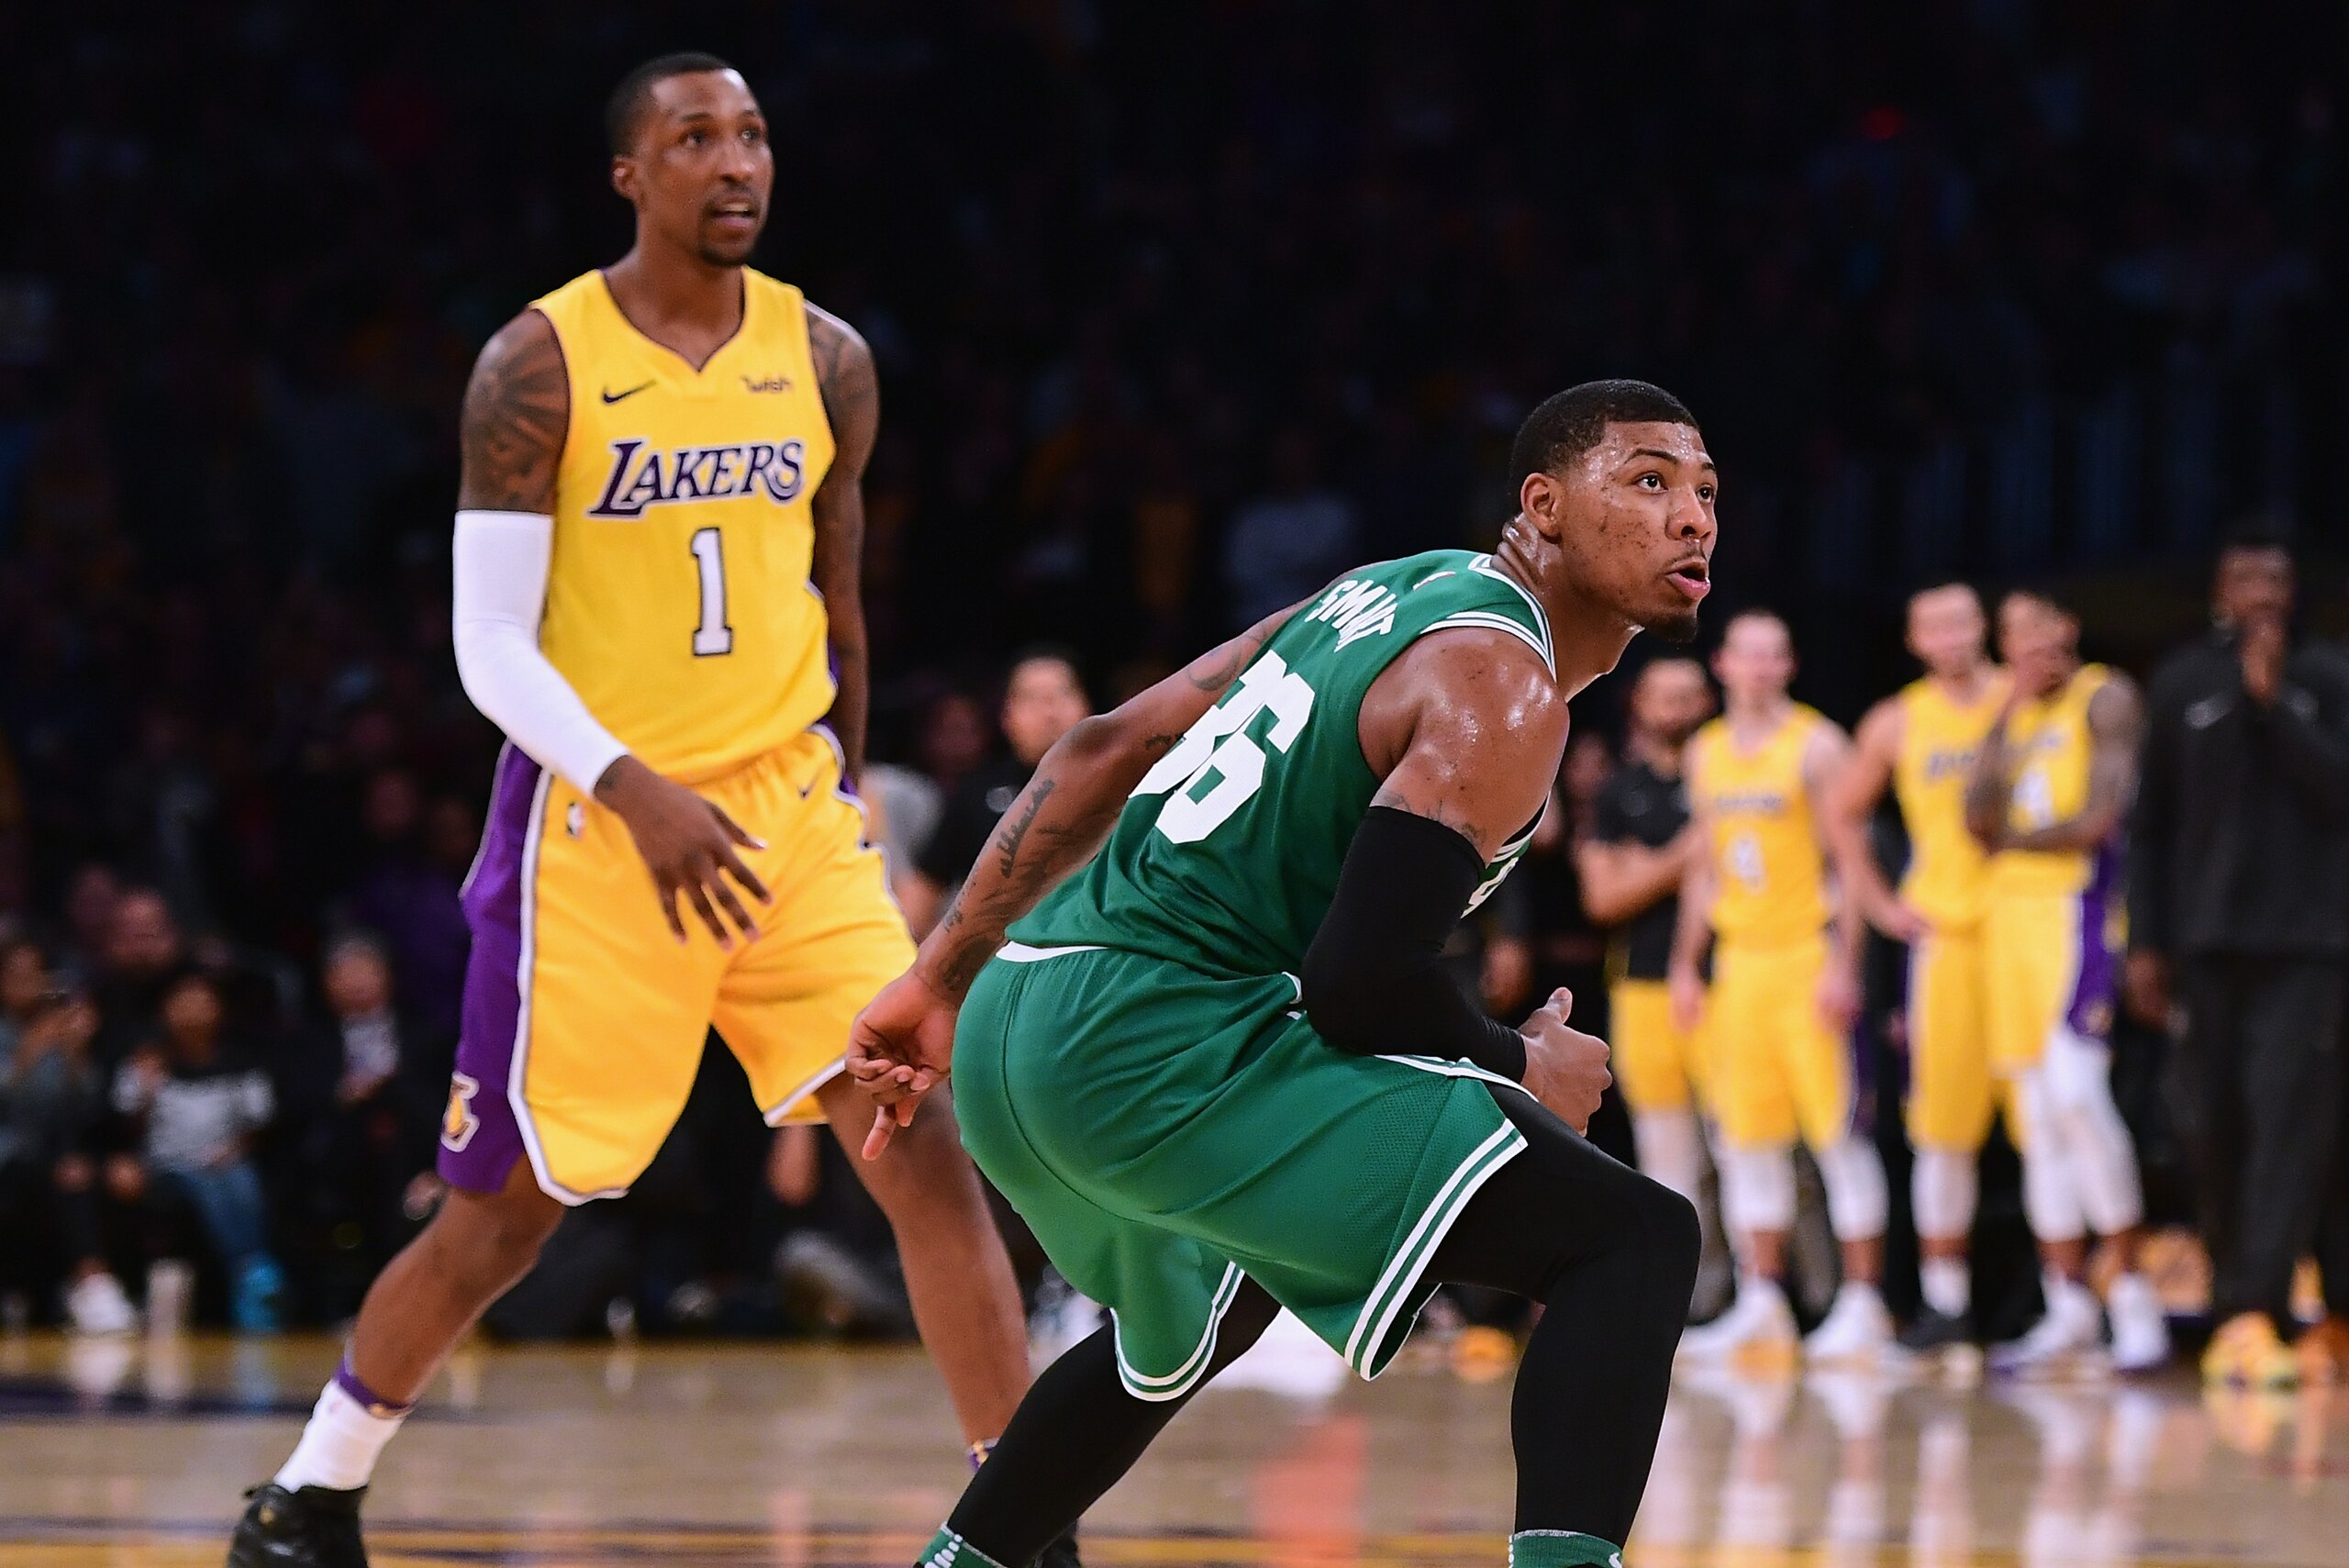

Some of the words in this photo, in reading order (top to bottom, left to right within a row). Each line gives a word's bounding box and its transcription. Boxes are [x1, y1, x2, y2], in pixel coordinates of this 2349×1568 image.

[586, 438, 804, 519] LAKERS
[690, 526, 732, 657] 1
[1304, 579, 1398, 653] SMT
[1128, 649, 1316, 845] 36
